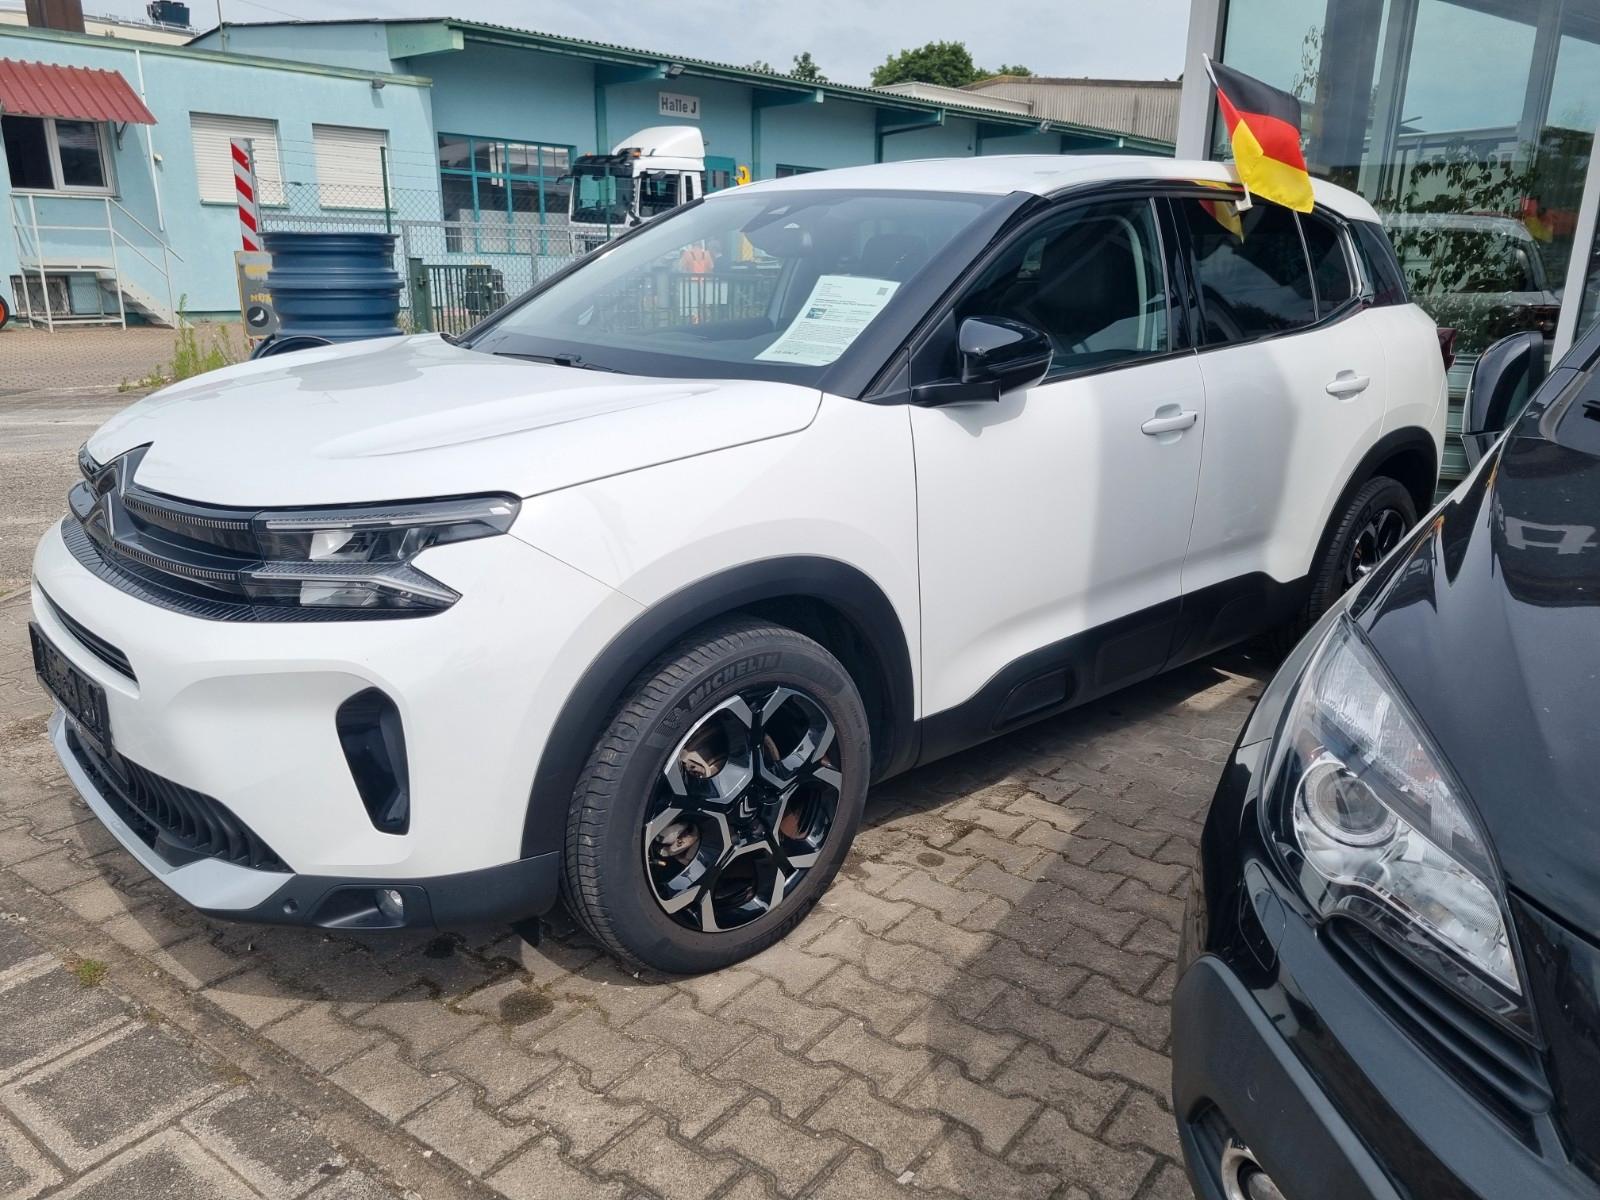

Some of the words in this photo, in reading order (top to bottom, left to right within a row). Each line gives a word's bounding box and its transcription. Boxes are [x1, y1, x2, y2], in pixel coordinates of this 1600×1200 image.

[661, 96, 688, 113] Halle
[691, 101, 697, 114] J
[688, 654, 780, 708] MICHELIN
